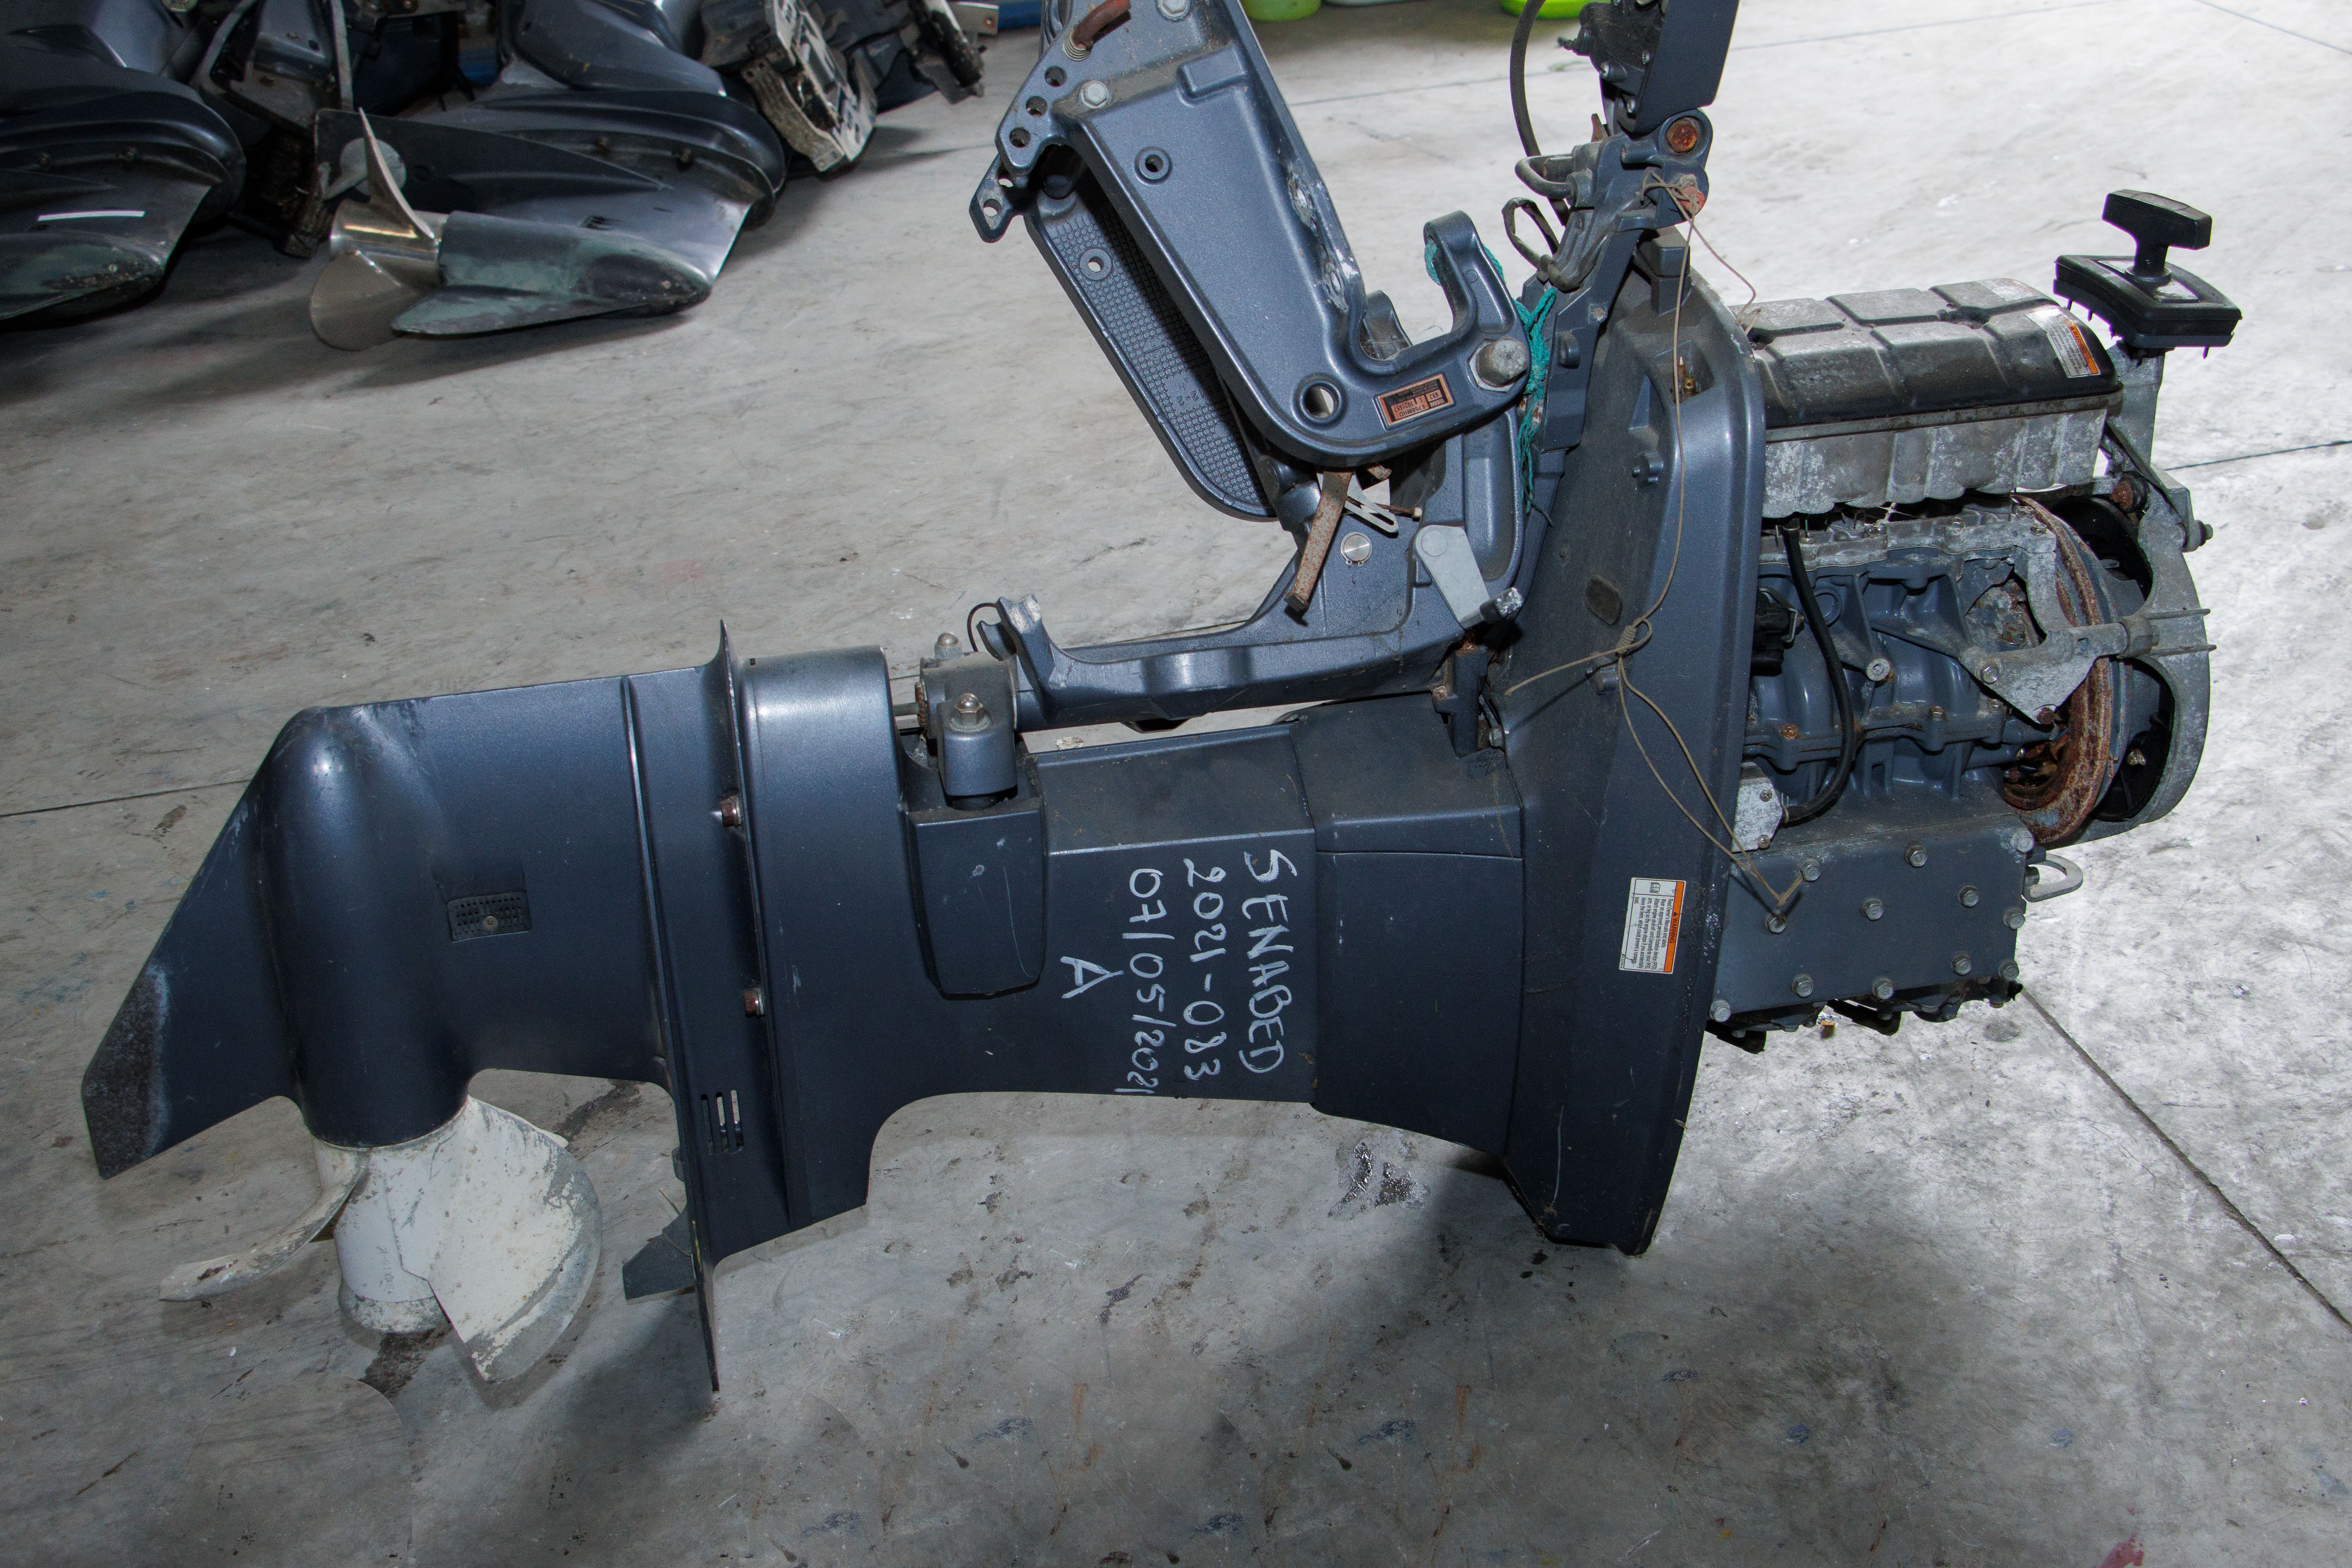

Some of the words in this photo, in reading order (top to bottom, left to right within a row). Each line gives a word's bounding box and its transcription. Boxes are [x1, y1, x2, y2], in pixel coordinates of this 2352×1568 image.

[2062, 344, 2072, 358] electrical
[1060, 956, 1124, 999] A
[1114, 868, 1177, 1094] 07/05/2021
[1183, 858, 1227, 1080] 2021-083
[1239, 849, 1297, 1073] SENABED
[1637, 952, 1645, 969] accidentally
